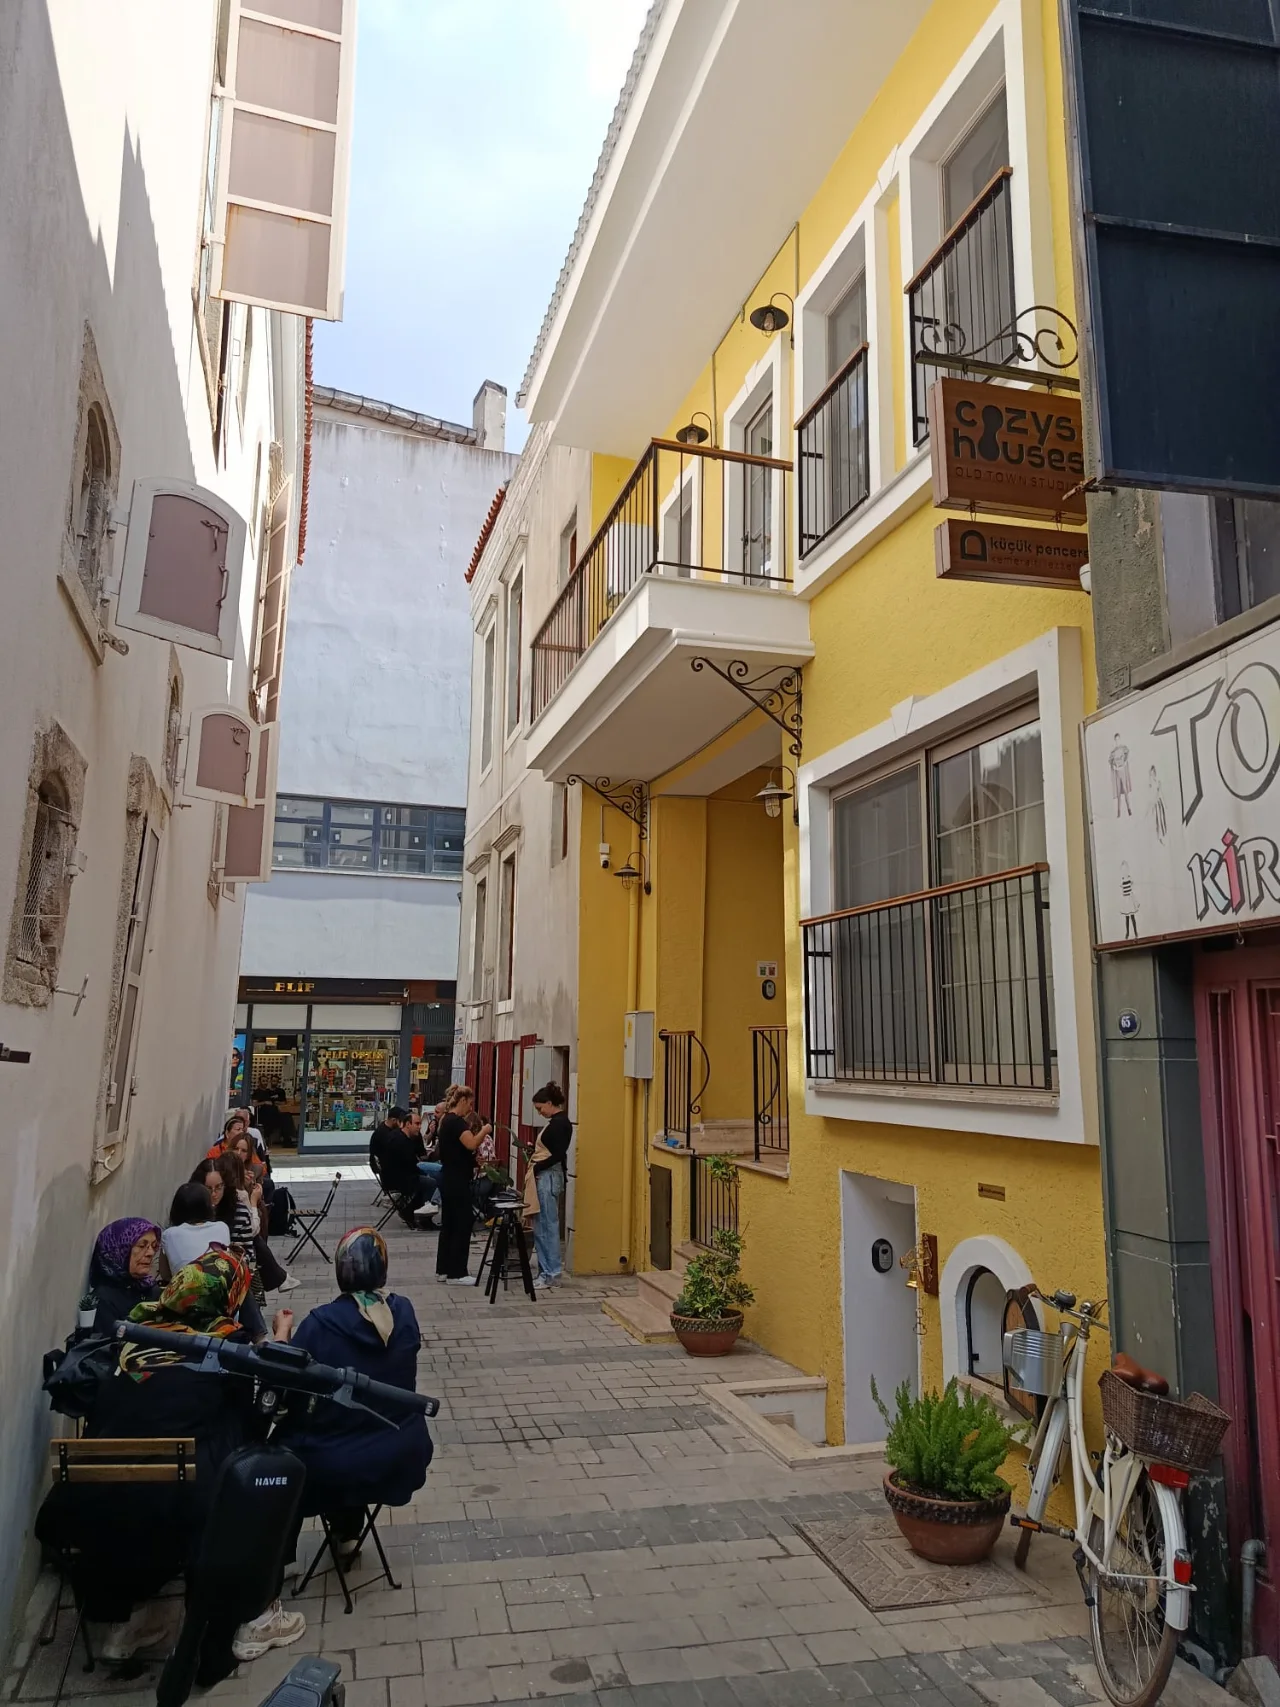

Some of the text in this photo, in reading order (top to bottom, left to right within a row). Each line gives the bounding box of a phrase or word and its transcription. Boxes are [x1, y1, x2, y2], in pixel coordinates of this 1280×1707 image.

[955, 466, 982, 480] OLD
[987, 471, 1028, 487] TOWN
[990, 536, 1032, 554] küçük
[1121, 1015, 1131, 1028] 65
[255, 1476, 288, 1486] NAVEE
